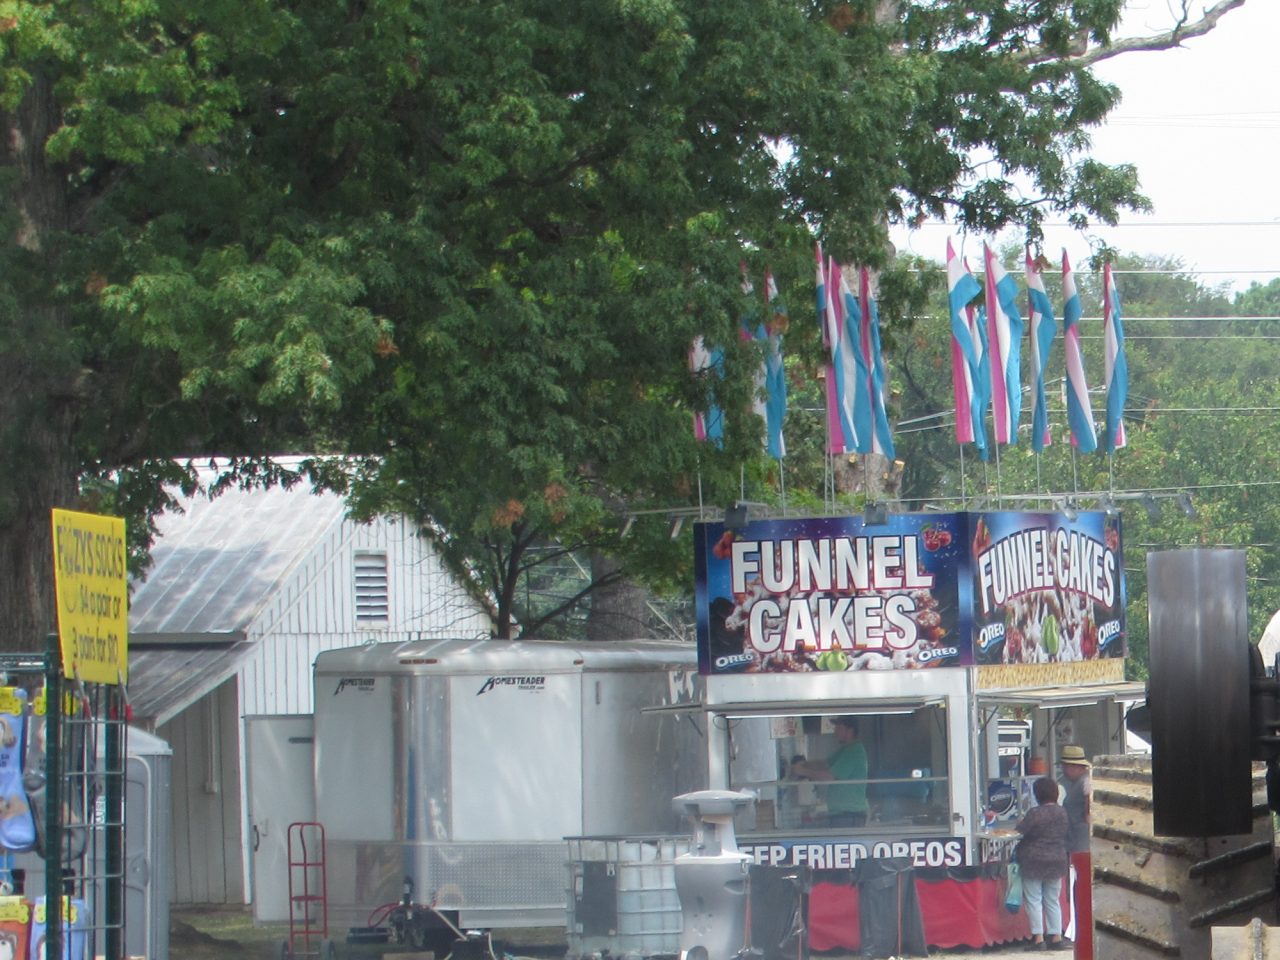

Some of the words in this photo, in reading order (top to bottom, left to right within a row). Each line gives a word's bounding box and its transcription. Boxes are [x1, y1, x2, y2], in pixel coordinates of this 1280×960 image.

[731, 535, 935, 594] FUNNEL
[978, 527, 1055, 615] FUNNEL
[1055, 527, 1116, 609] CAKES
[750, 594, 918, 653] CAKES
[979, 622, 1005, 648] OREO
[1098, 621, 1121, 646] OREO
[715, 652, 754, 669] OREO
[918, 646, 958, 662] OREO
